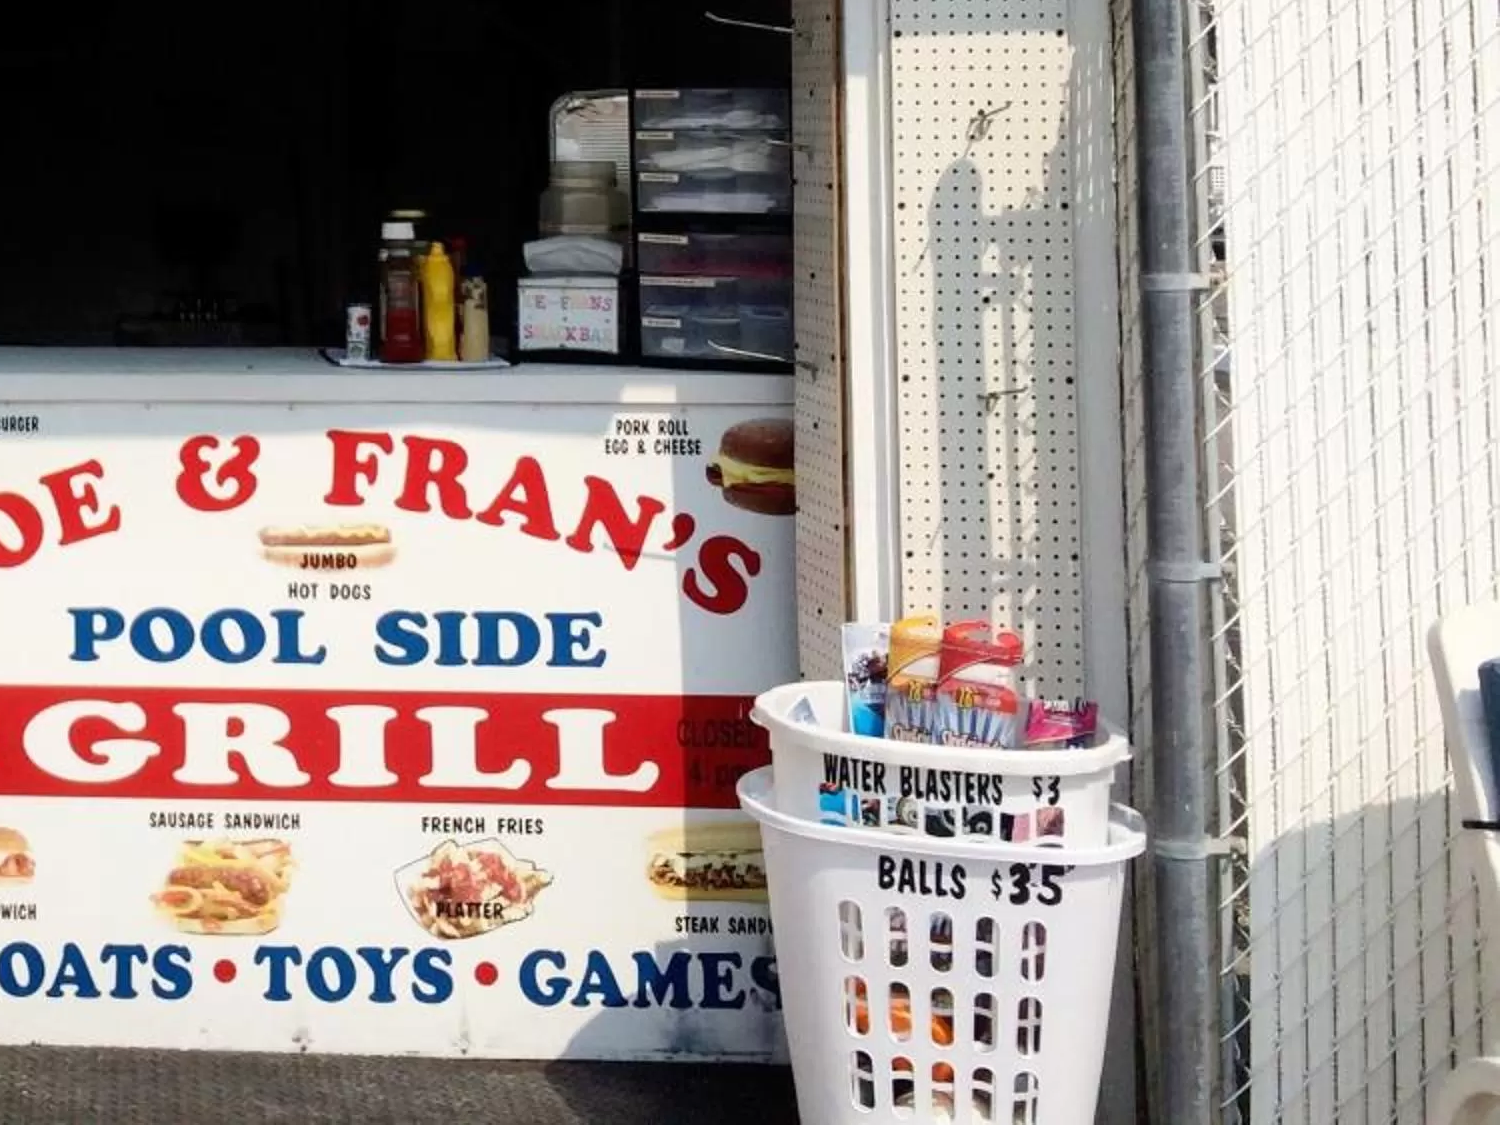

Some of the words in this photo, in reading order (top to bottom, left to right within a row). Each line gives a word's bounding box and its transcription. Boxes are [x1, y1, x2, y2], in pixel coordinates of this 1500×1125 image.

[616, 419, 650, 435] PORK
[657, 419, 689, 436] ROLL
[605, 438, 629, 455] EGG
[637, 439, 646, 455] &
[653, 438, 702, 456] CHEESE
[175, 434, 261, 512] &
[323, 429, 762, 616] FRAN'S
[300, 553, 358, 570] JUMBO
[288, 582, 318, 600] HOT
[330, 583, 372, 601] DOGS
[68, 606, 327, 665] POOL
[374, 610, 608, 668] SIDE
[21, 699, 661, 793] GRILL
[823, 752, 887, 794] WATER
[901, 765, 1004, 806] BLASTERS
[1032, 774, 1062, 806] $3
[149, 812, 215, 829] SAUSAGE
[224, 813, 301, 831] SANDWICH
[421, 816, 486, 835] FRENCH
[497, 818, 544, 835] FRIES
[878, 854, 967, 900] BALLS
[436, 901, 504, 920] PLATTER
[675, 916, 720, 934] STEAK
[727, 917, 773, 936] SAND
[254, 945, 454, 1003] TOYS
[518, 950, 783, 1013] GAMES
